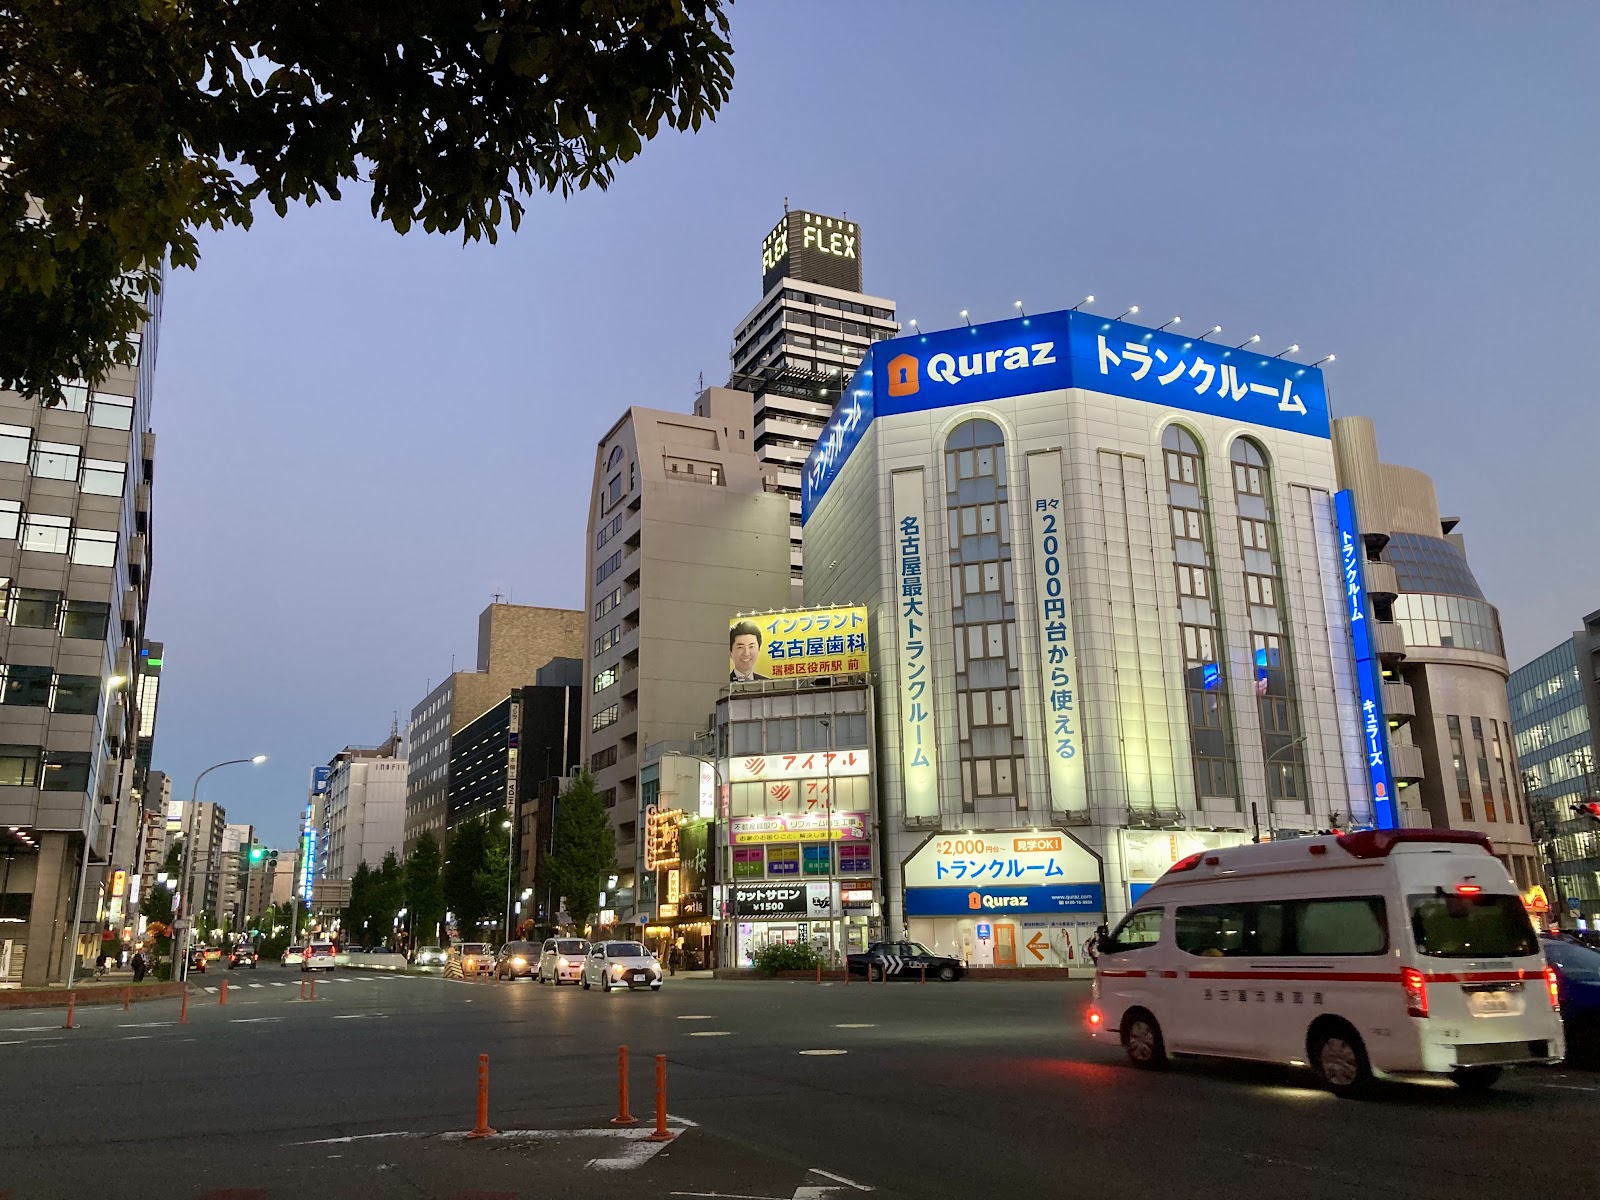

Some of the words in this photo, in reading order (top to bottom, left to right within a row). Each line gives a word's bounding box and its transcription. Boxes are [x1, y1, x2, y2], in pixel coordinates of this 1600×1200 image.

[762, 229, 788, 276] FLEX
[803, 226, 856, 259] FLEX
[926, 341, 1056, 386] Quraz
[1097, 334, 1307, 416] トランクルーム
[1342, 530, 1364, 622] トランクルーム
[766, 611, 864, 636] インプラント
[1035, 498, 1076, 759] 月々2000円台から使える
[767, 633, 866, 660] 名古屋歯科
[899, 515, 930, 767] 名古屋最大トランクルーム
[1362, 699, 1384, 767] キュラーズ
[782, 752, 857, 771] アイフル
[806, 783, 830, 795] アイ
[1016, 838, 1060, 851] 見学OK!
[936, 858, 1064, 880] トランクルーム
[736, 889, 801, 902] カットサロン
[753, 902, 784, 911] ¥1500
[982, 894, 1029, 909] Quraz
